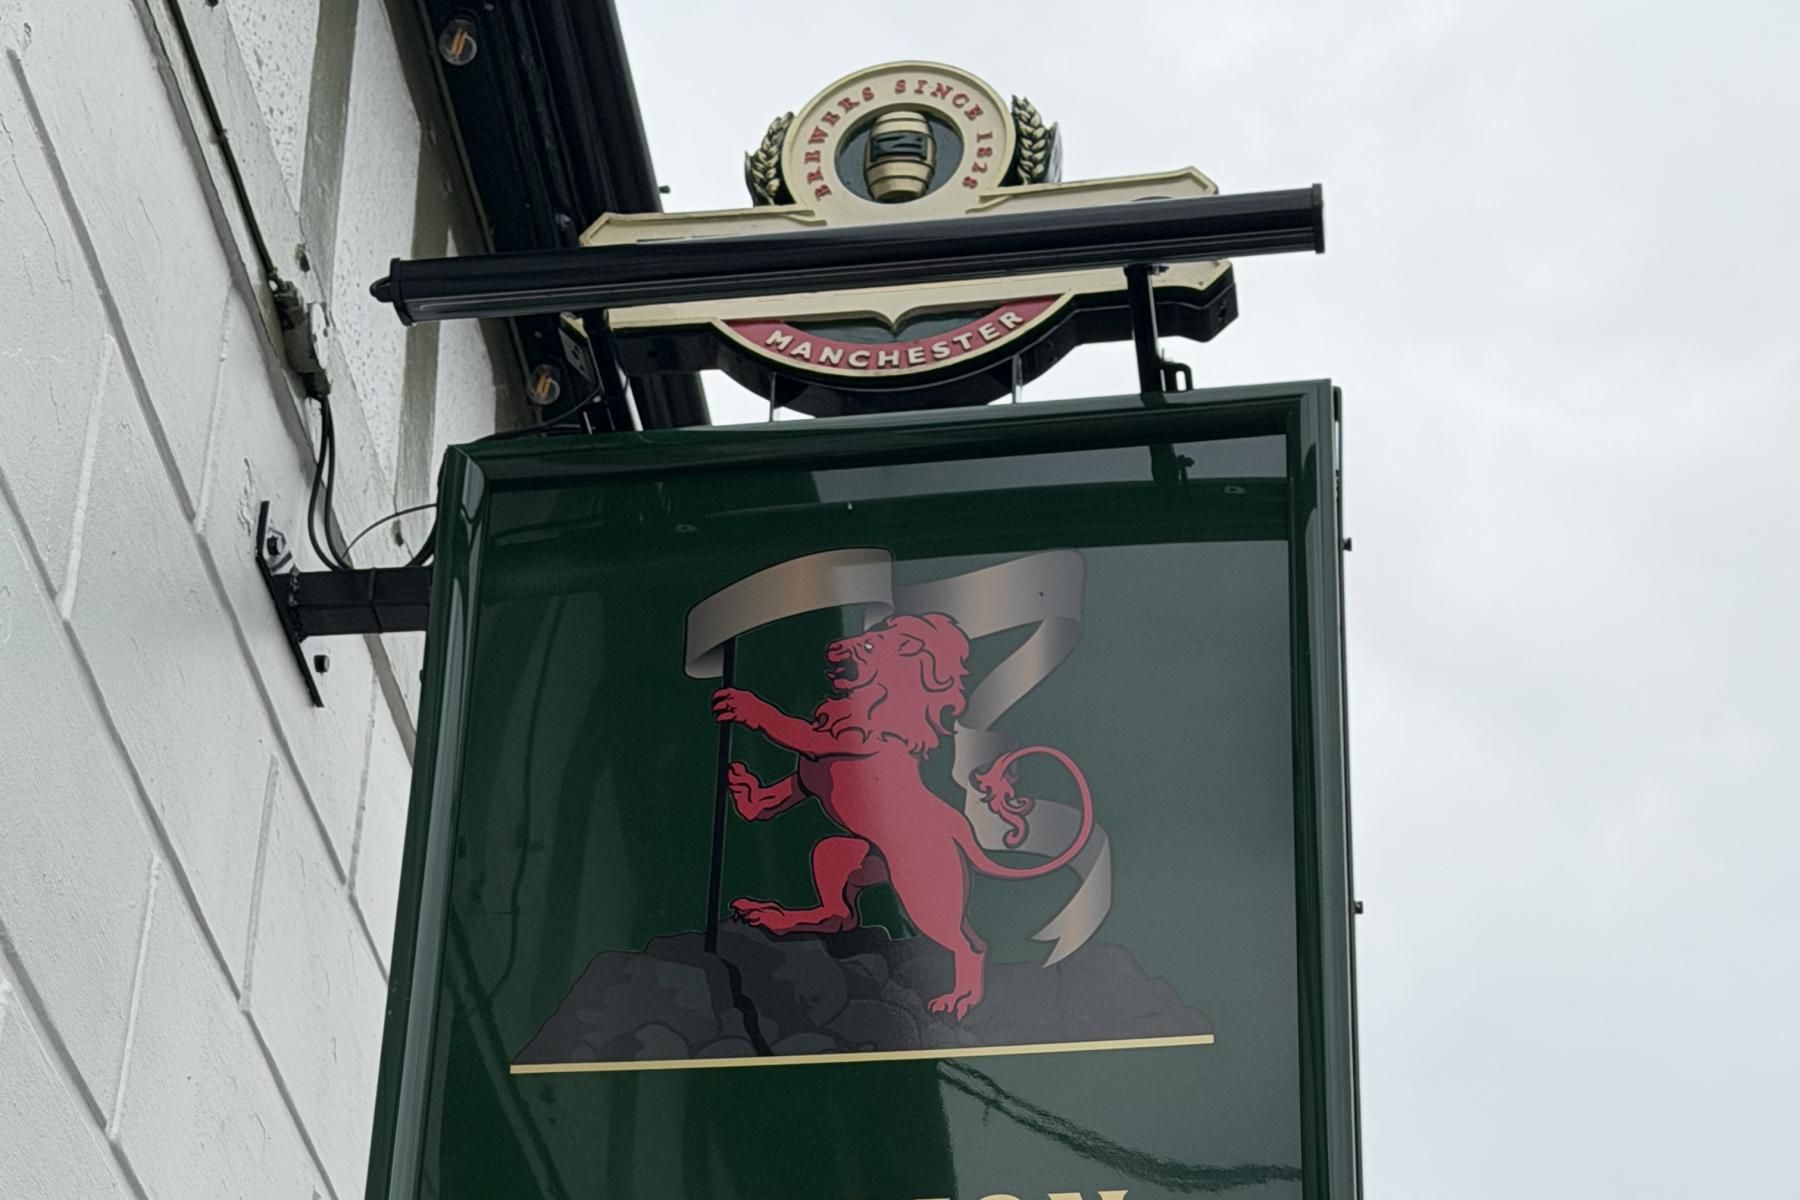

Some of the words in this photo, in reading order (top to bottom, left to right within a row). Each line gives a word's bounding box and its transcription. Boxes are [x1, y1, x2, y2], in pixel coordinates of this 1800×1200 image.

[894, 78, 984, 122] SINCE
[962, 129, 993, 189] 1828
[765, 309, 1026, 369] MANCHESTER
